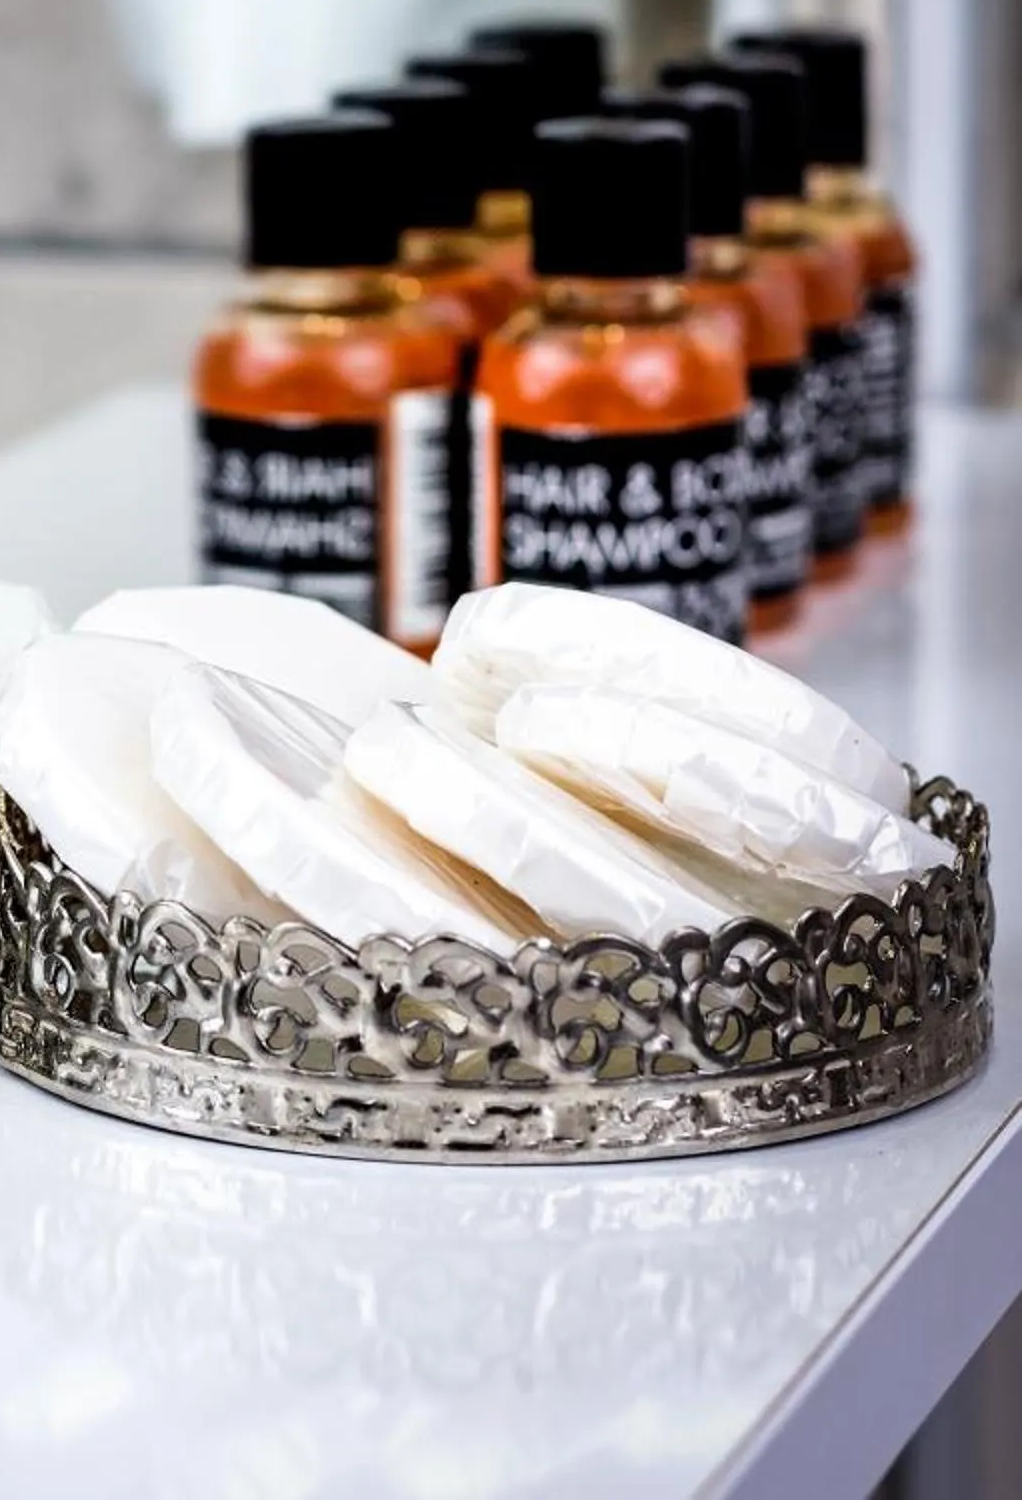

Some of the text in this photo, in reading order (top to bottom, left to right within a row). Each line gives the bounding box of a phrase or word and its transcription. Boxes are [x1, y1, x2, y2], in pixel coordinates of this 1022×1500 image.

[505, 462, 612, 516] HAIR
[619, 461, 664, 519] &
[505, 506, 743, 574] SHAMPOO
